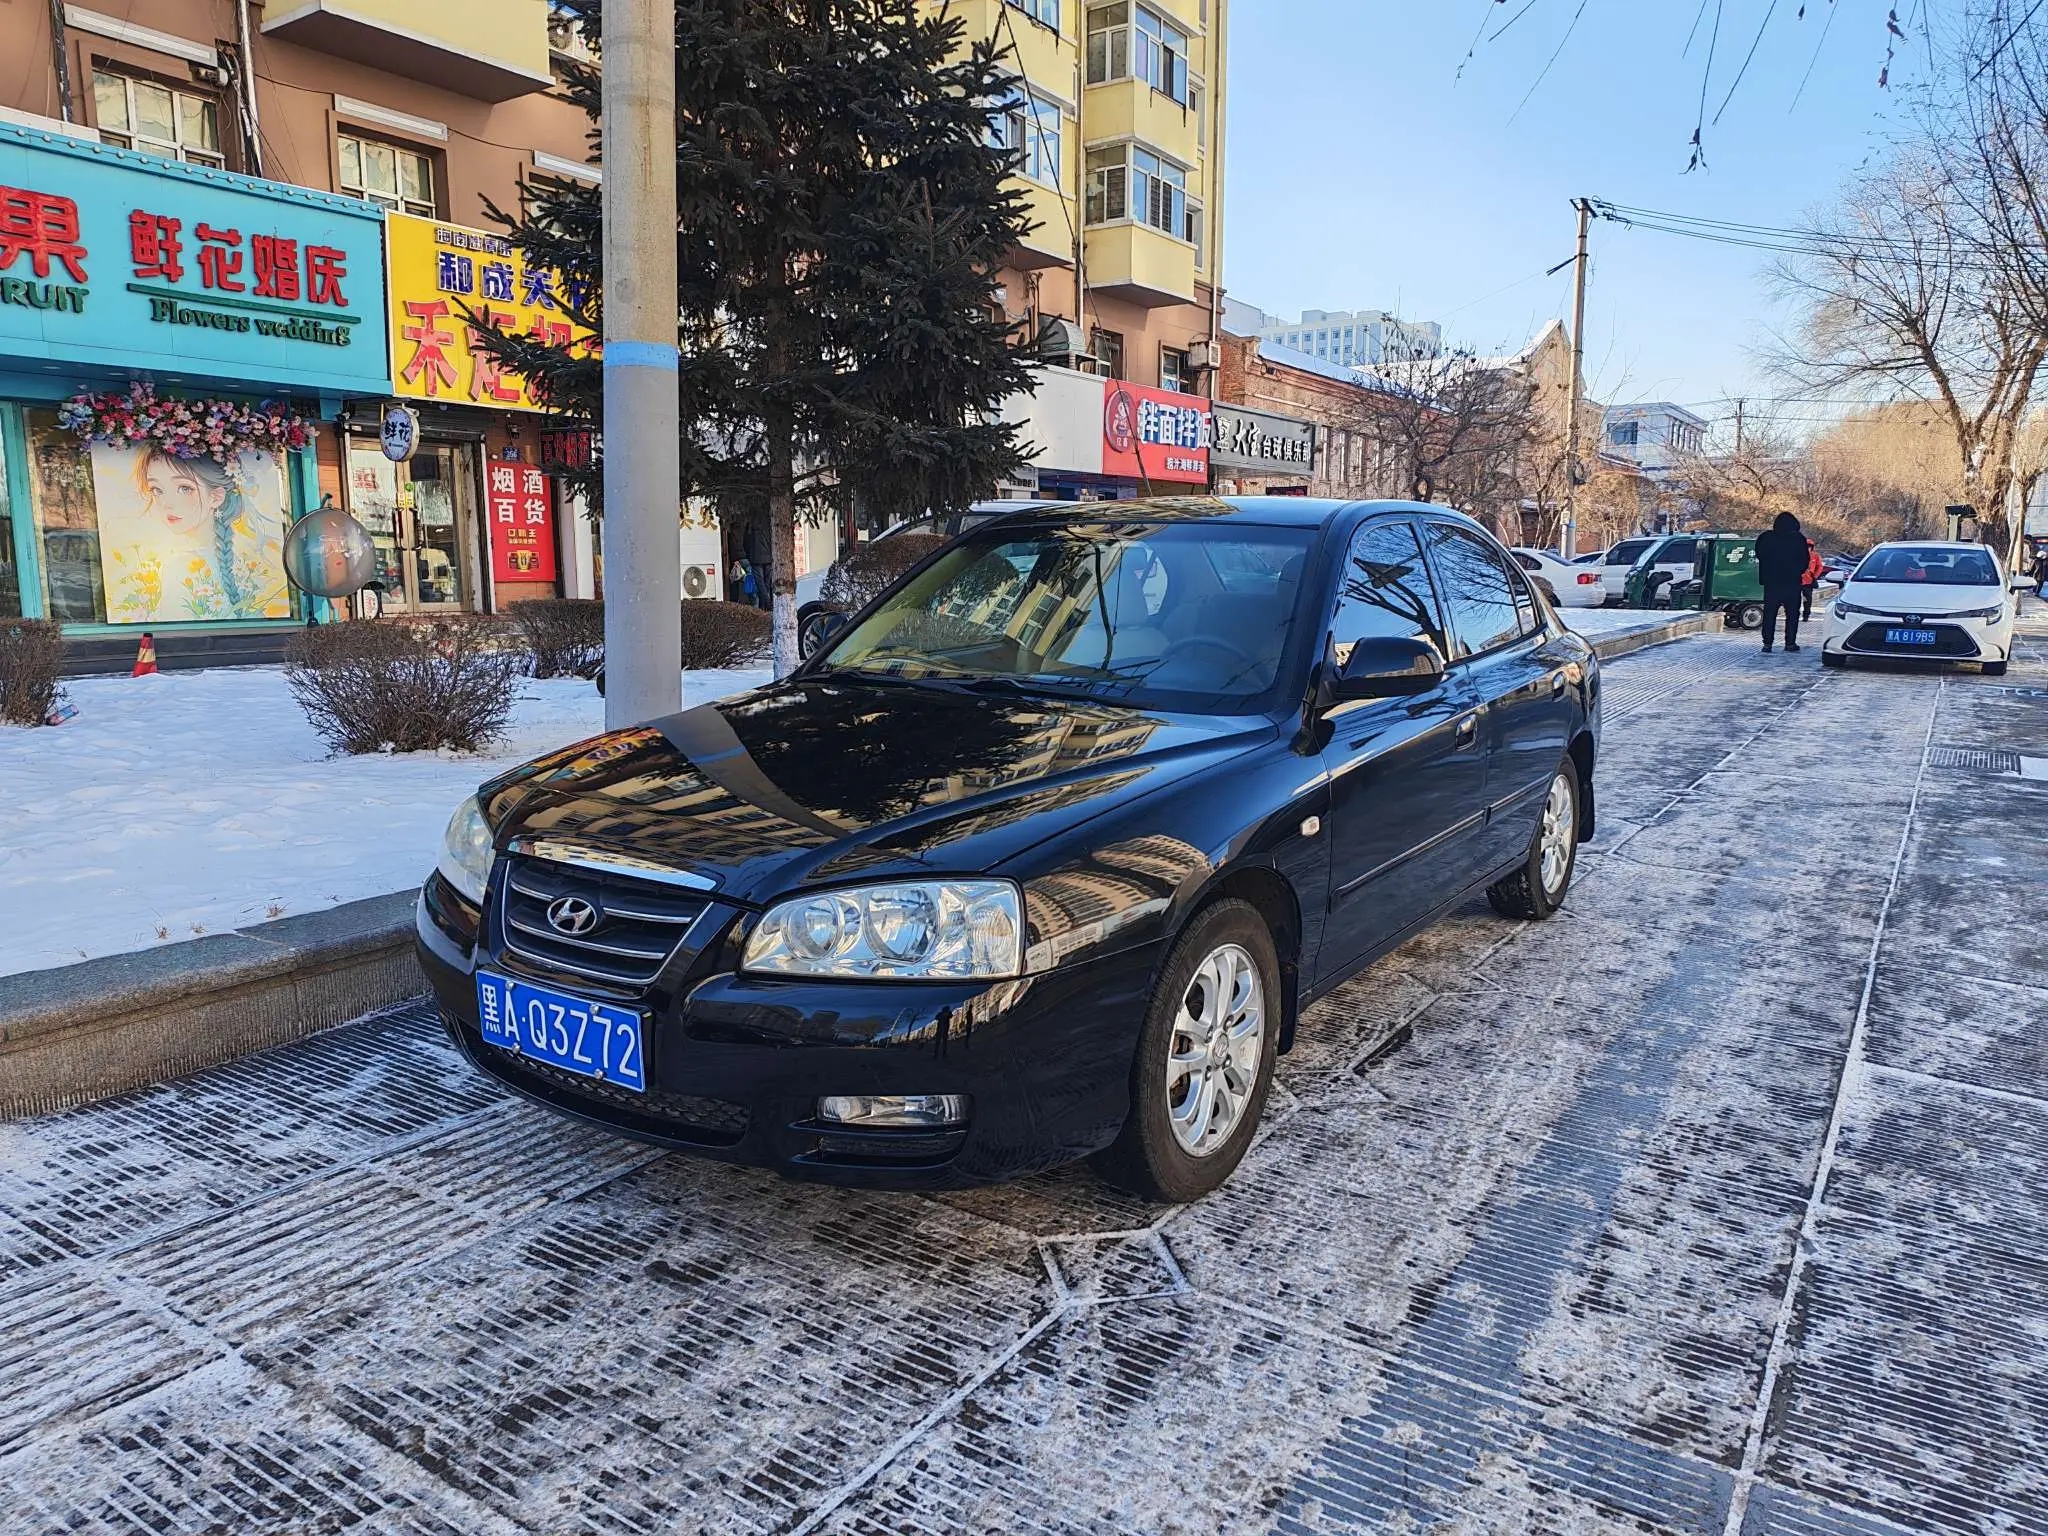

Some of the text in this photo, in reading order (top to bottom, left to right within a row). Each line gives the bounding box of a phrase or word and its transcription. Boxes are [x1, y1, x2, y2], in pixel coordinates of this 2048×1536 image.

[0, 185, 349, 307] 果 鲜花婚庆
[150, 297, 250, 333] Flowers
[254, 317, 351, 347] wedding
[384, 420, 410, 443] 鲜花
[1138, 400, 1211, 450] 拌面拌饭
[492, 466, 544, 495] 烟酒
[493, 498, 546, 525] 百货
[481, 983, 639, 1078] 黑A·Q3Z72
